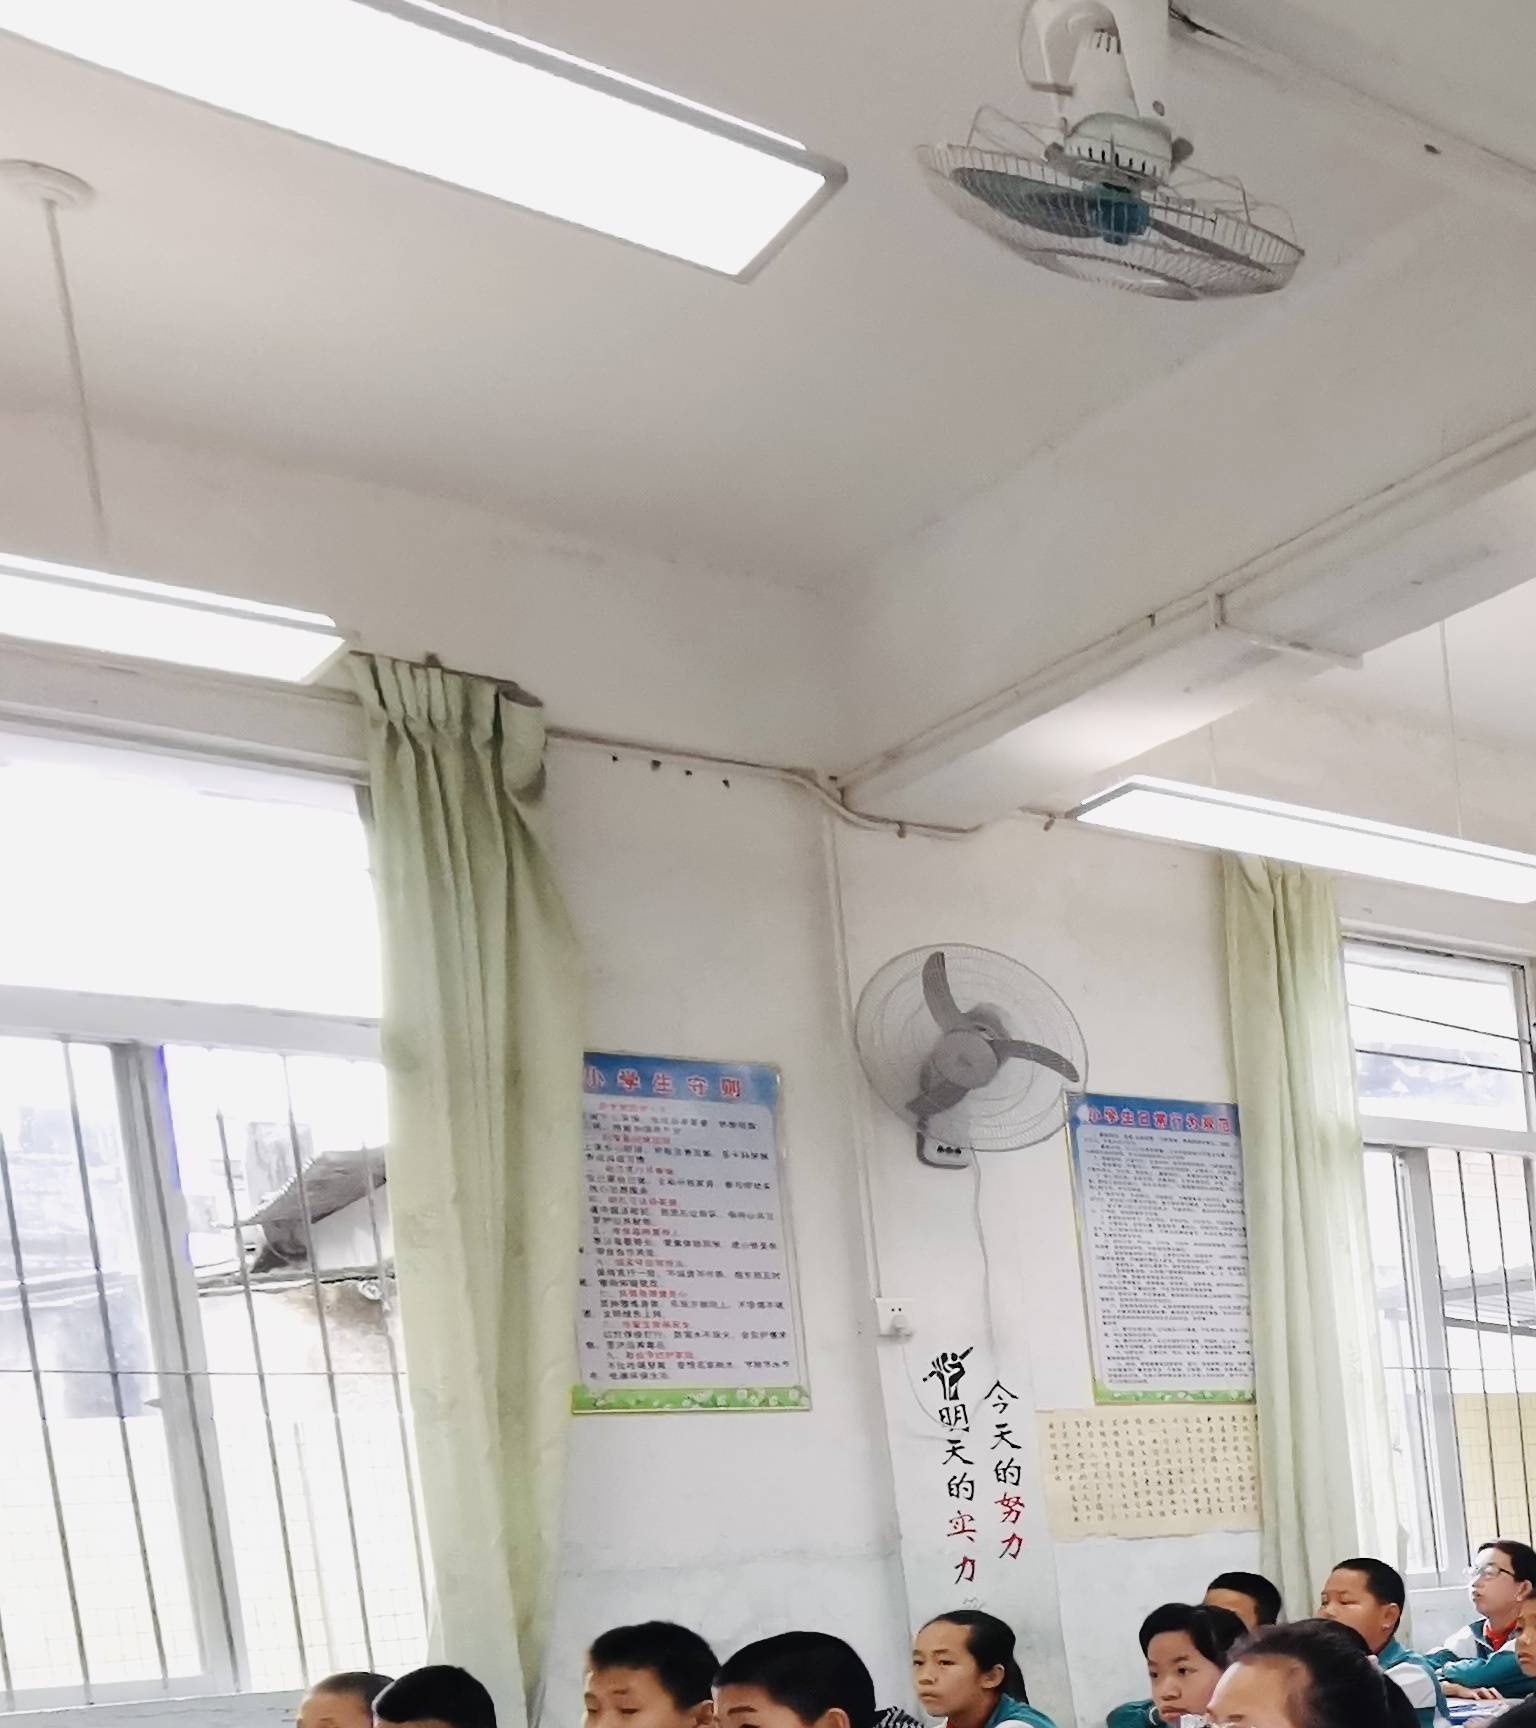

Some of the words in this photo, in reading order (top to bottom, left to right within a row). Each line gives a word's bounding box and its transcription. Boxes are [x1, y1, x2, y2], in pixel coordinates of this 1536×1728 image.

[939, 1403, 977, 1585] 明天的实力
[985, 1380, 1025, 1559] 今天的努力
